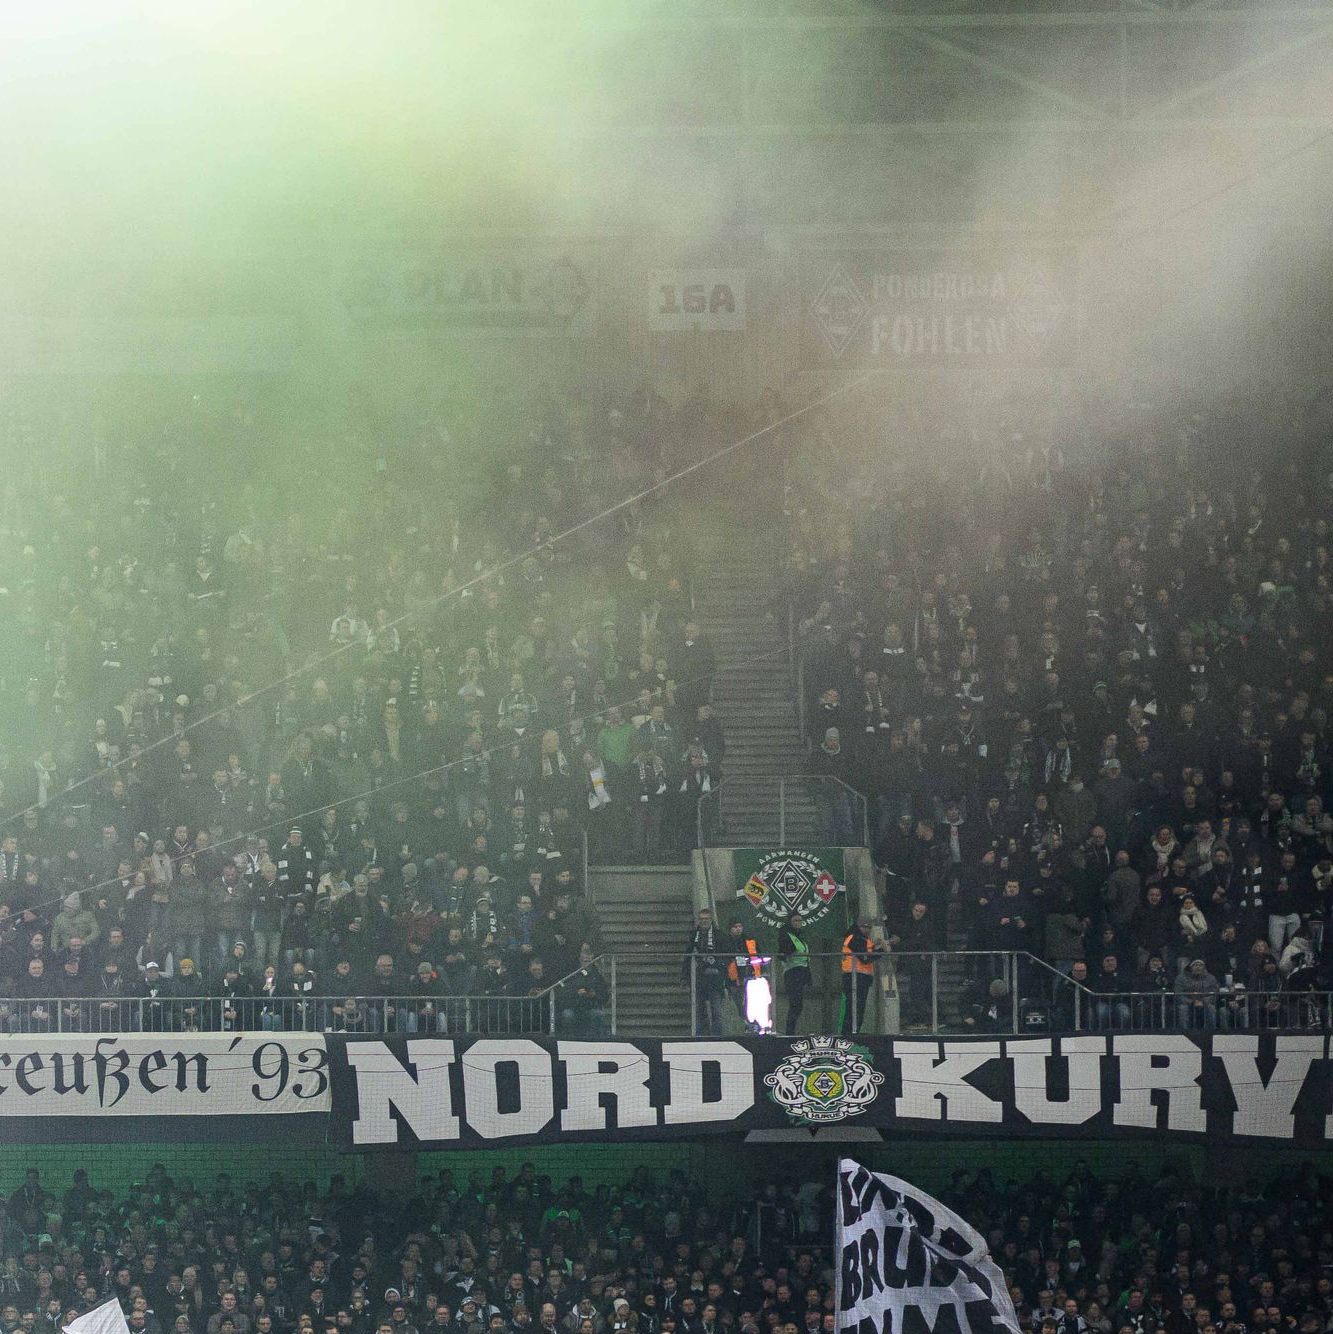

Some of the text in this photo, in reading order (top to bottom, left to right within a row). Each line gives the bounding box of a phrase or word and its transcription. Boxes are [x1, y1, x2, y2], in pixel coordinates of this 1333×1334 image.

[658, 284, 736, 313] 16A
[869, 315, 1008, 355] FOHLEN
[759, 850, 820, 865] AARWANGEN
[756, 906, 830, 929] POWE OHLEN
[349, 1036, 1333, 1144] NORD KURV
